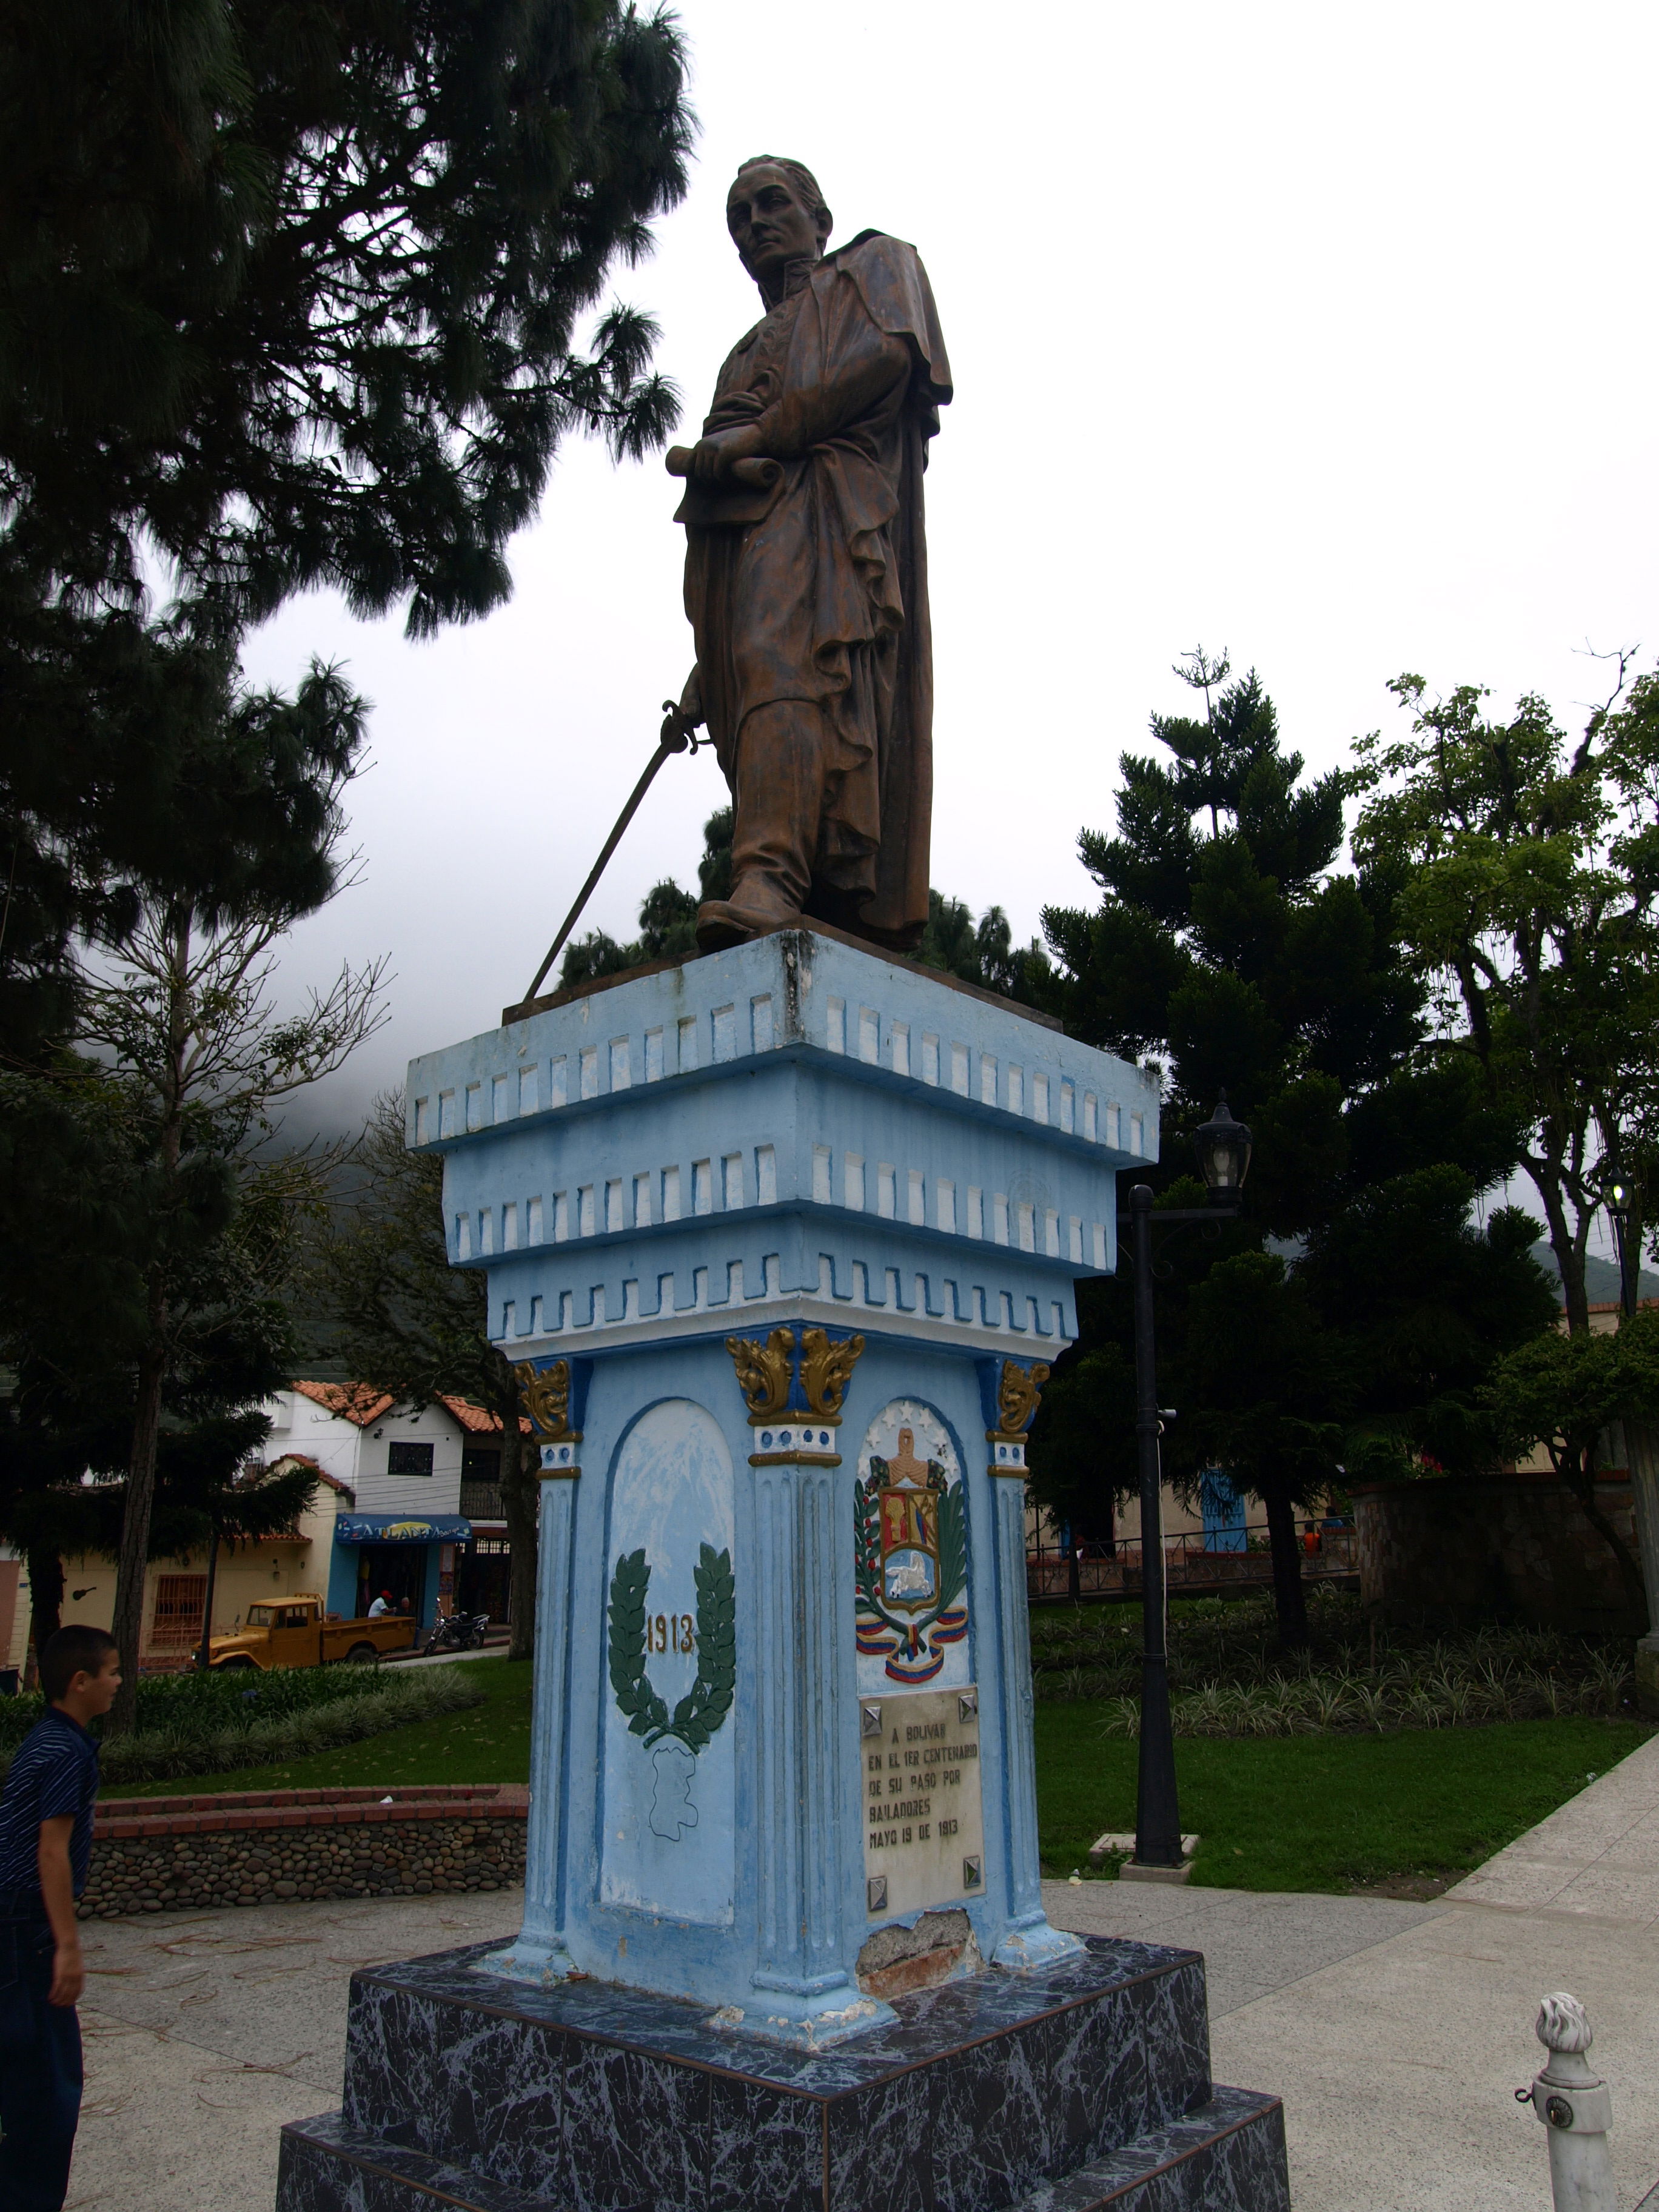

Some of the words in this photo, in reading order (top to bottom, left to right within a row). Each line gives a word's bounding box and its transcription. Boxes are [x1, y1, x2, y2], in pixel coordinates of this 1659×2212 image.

[364, 1524, 441, 1539] ATLANTA
[648, 1614, 692, 1653] 1913
[892, 1728, 899, 1743] A
[907, 1723, 945, 1740] BOLIVAR
[869, 1755, 882, 1771] EN
[889, 1753, 900, 1768] EL
[905, 1751, 919, 1766] 1ER
[924, 1744, 977, 1764] CENTENARIO
[869, 1780, 882, 1797] DE
[889, 1777, 902, 1793] SU
[911, 1772, 936, 1790] PASO
[943, 1769, 960, 1786] POR
[870, 1798, 930, 1823] BAILADORES
[870, 1830, 897, 1849] MAYO
[903, 1827, 911, 1843] 19
[919, 1823, 930, 1840] DE
[939, 1820, 958, 1836] 1913
